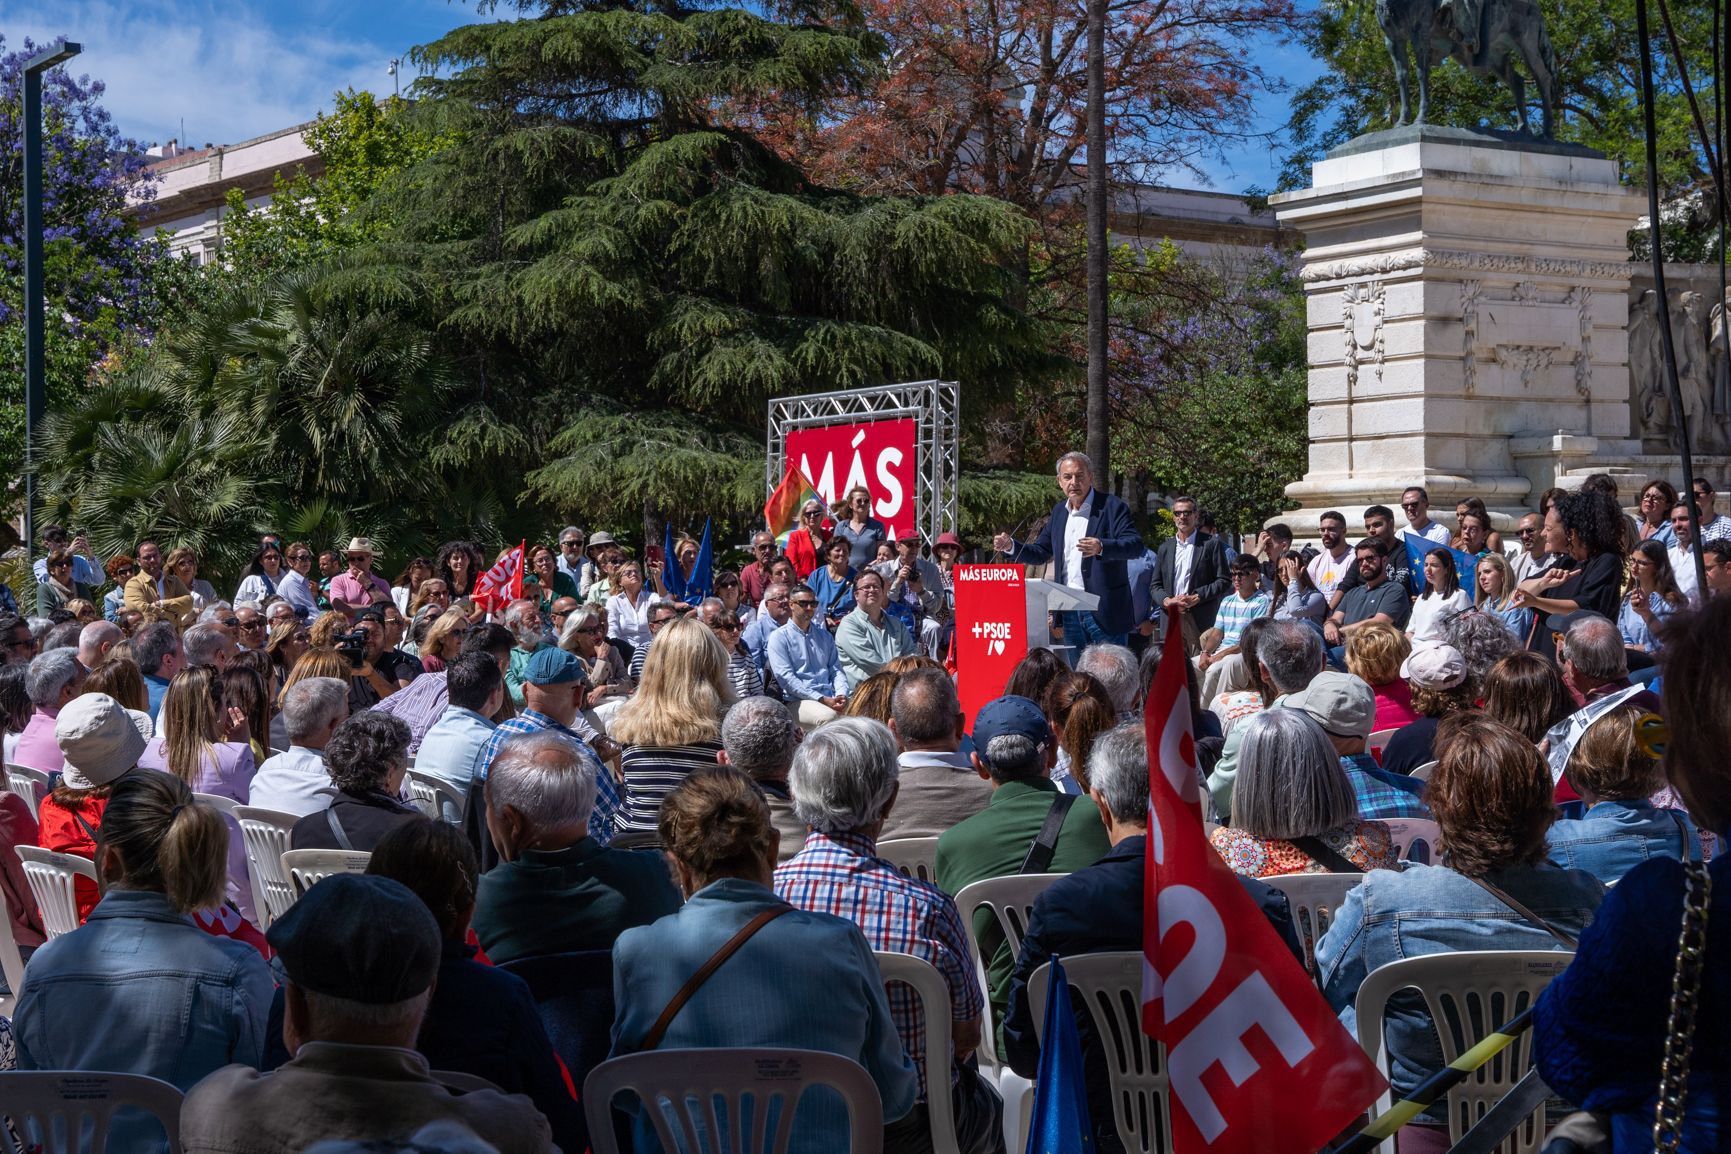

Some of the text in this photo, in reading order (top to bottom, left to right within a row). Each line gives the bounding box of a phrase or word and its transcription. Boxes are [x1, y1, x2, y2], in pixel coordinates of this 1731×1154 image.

[801, 429, 903, 518] MÁS
[960, 566, 1019, 581] MÁS EUROPA
